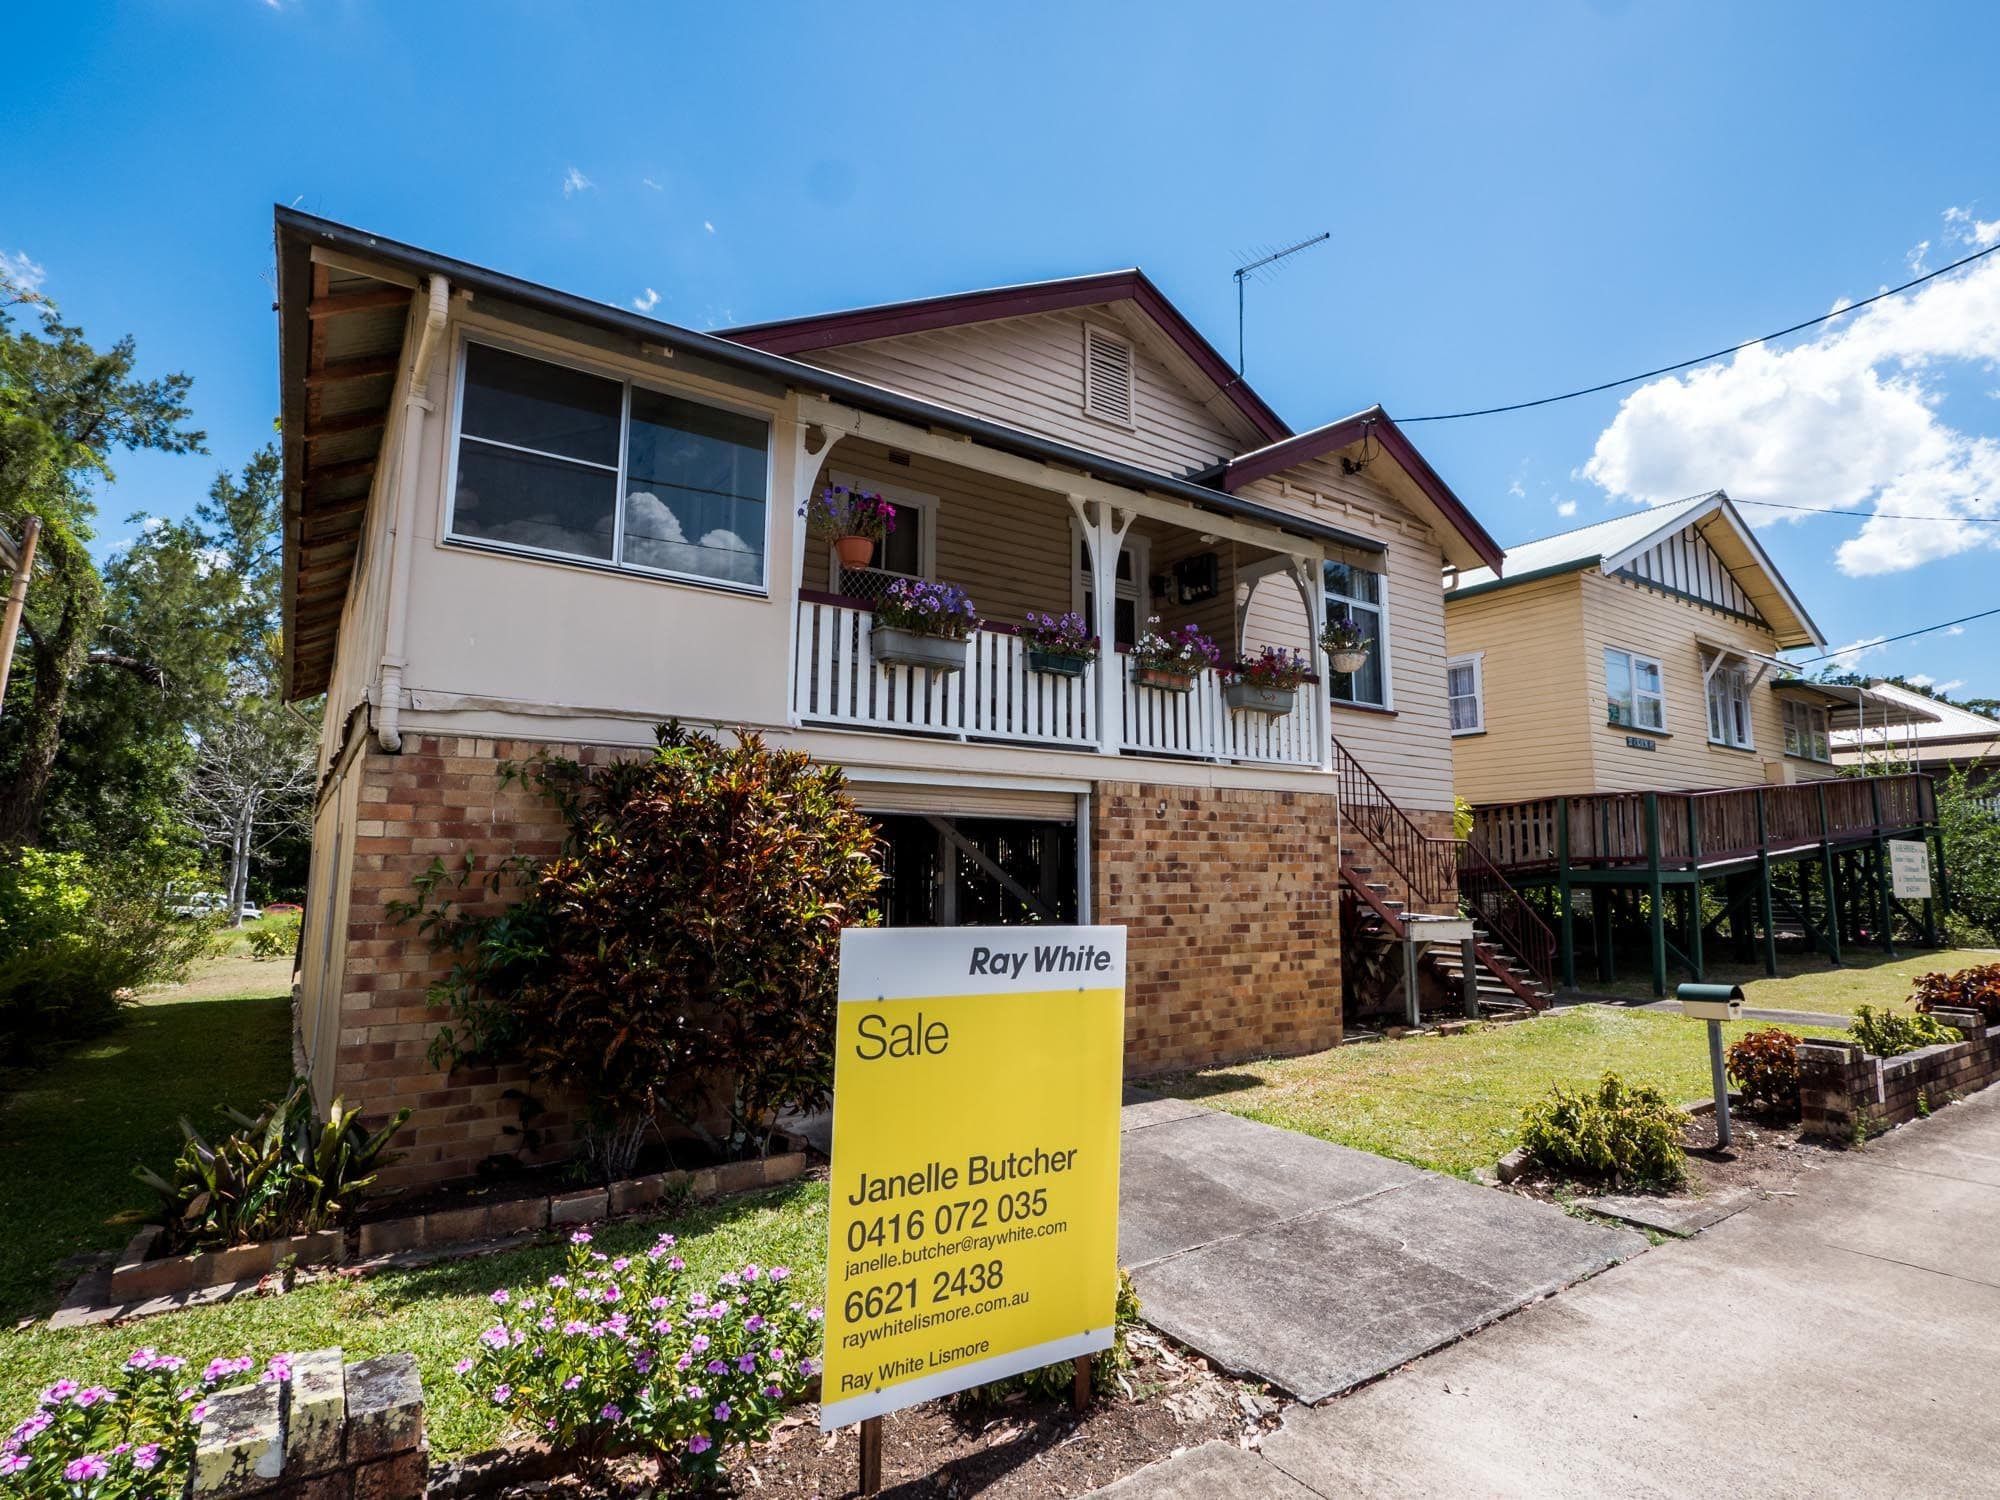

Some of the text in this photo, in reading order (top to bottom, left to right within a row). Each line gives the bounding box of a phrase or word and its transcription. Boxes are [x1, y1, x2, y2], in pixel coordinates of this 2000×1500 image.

[969, 945, 1111, 979] Ray White
[855, 1012, 949, 1061] Sale
[848, 1147, 1078, 1206] Janelle Butcher
[847, 1188, 1048, 1253] 0416 072 035
[844, 1221, 1067, 1281] janelle.butcher@raywhite.com
[842, 1291, 1029, 1349] raywhitelismore.com.au
[844, 1259, 1004, 1324] 6621 2438
[841, 1339, 990, 1393] Ray White Lismore
